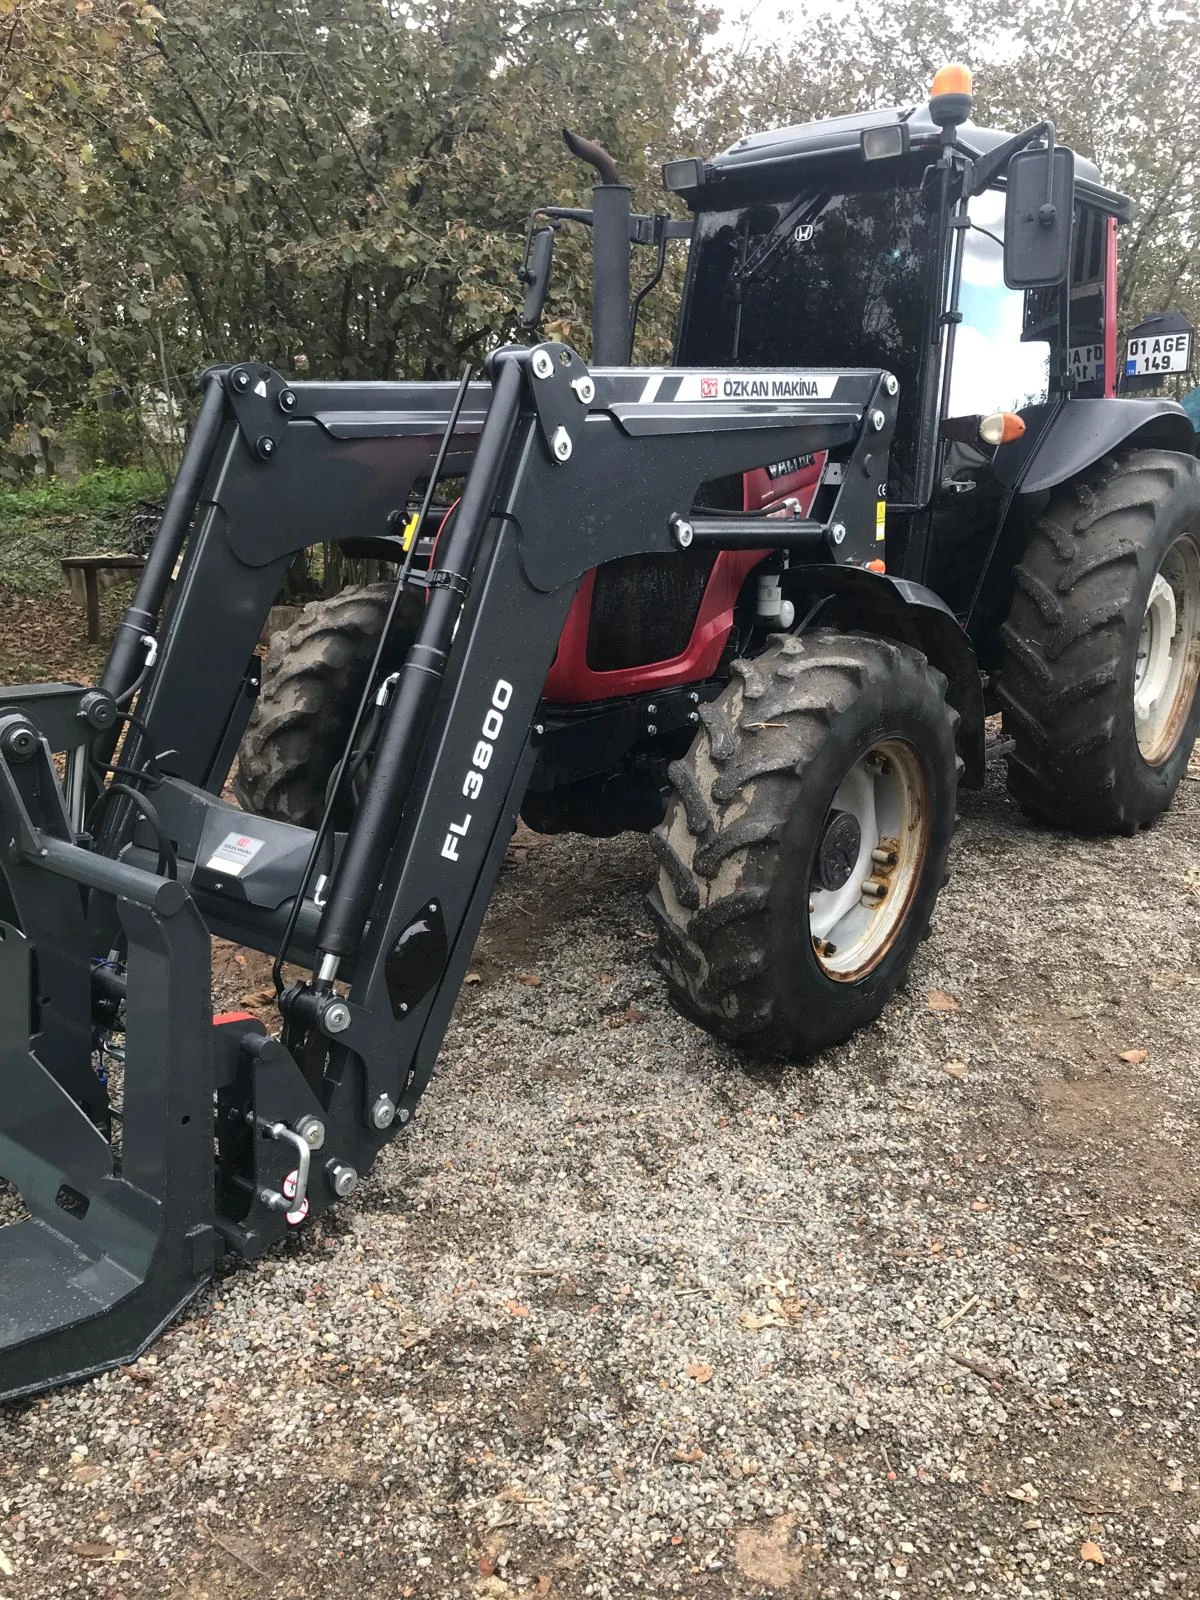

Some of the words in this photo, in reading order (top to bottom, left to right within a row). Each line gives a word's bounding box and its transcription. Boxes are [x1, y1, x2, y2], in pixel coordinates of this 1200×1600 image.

[1130, 340, 1147, 356] 01
[1152, 336, 1187, 354] AGE
[1144, 355, 1171, 371] 149
[724, 378, 769, 397] ÖZKAN
[772, 378, 819, 397] MAKİNA
[440, 813, 472, 861] FL
[462, 679, 513, 800] 3800
